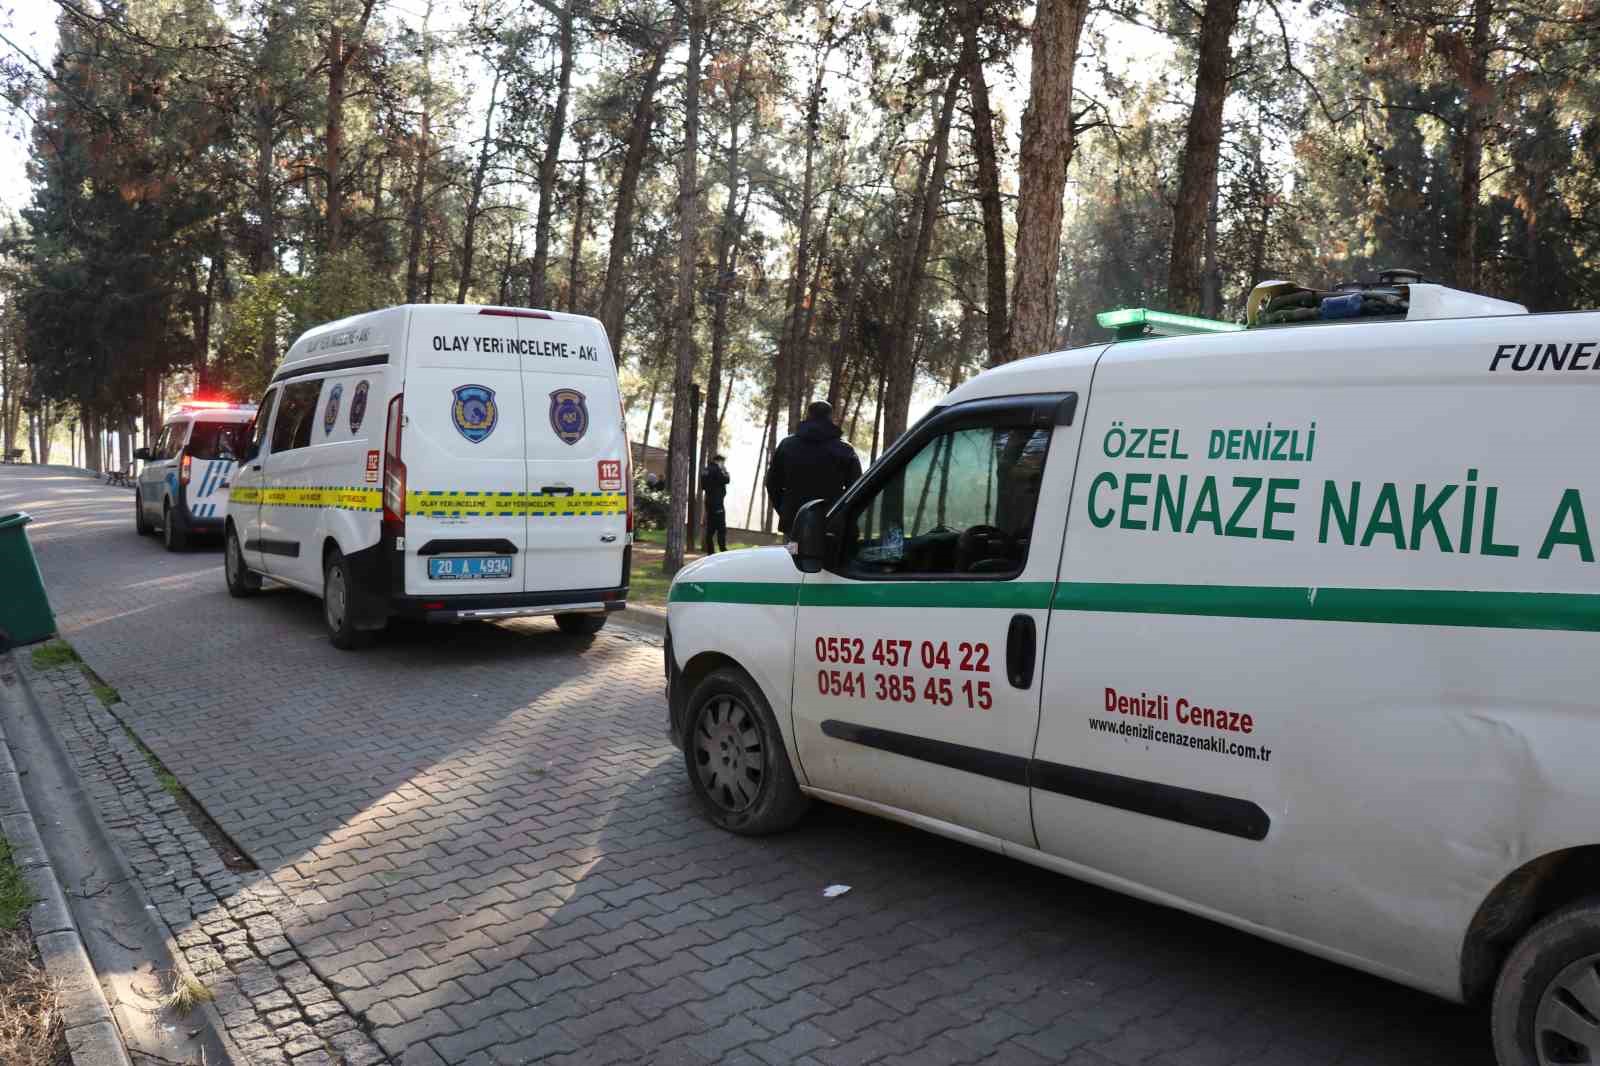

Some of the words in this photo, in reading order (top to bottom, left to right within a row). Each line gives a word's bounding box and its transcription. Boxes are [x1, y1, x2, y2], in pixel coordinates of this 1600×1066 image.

[432, 335, 470, 352] OLAY
[1488, 342, 1600, 372] FUNE
[1103, 421, 1188, 460] ÖZEL
[1207, 421, 1316, 462] DENİZLİ
[600, 463, 619, 478] 112
[1087, 471, 1300, 542] CENAZE
[1318, 468, 1520, 558] NAKİL
[438, 560, 453, 574] 20
[462, 560, 470, 574] A
[480, 559, 509, 574] 4934
[815, 637, 865, 664] 0552
[871, 639, 912, 667] 457
[920, 640, 951, 671] 04
[958, 642, 991, 674] 22
[817, 670, 866, 698] 0541
[874, 673, 915, 704] 385
[923, 676, 953, 707] 45
[961, 680, 993, 709] 15
[1104, 687, 1169, 721] Denizli
[1175, 698, 1254, 734] Cenaze
[1088, 717, 1273, 762] www.denizlicenazenakil.com.tr
